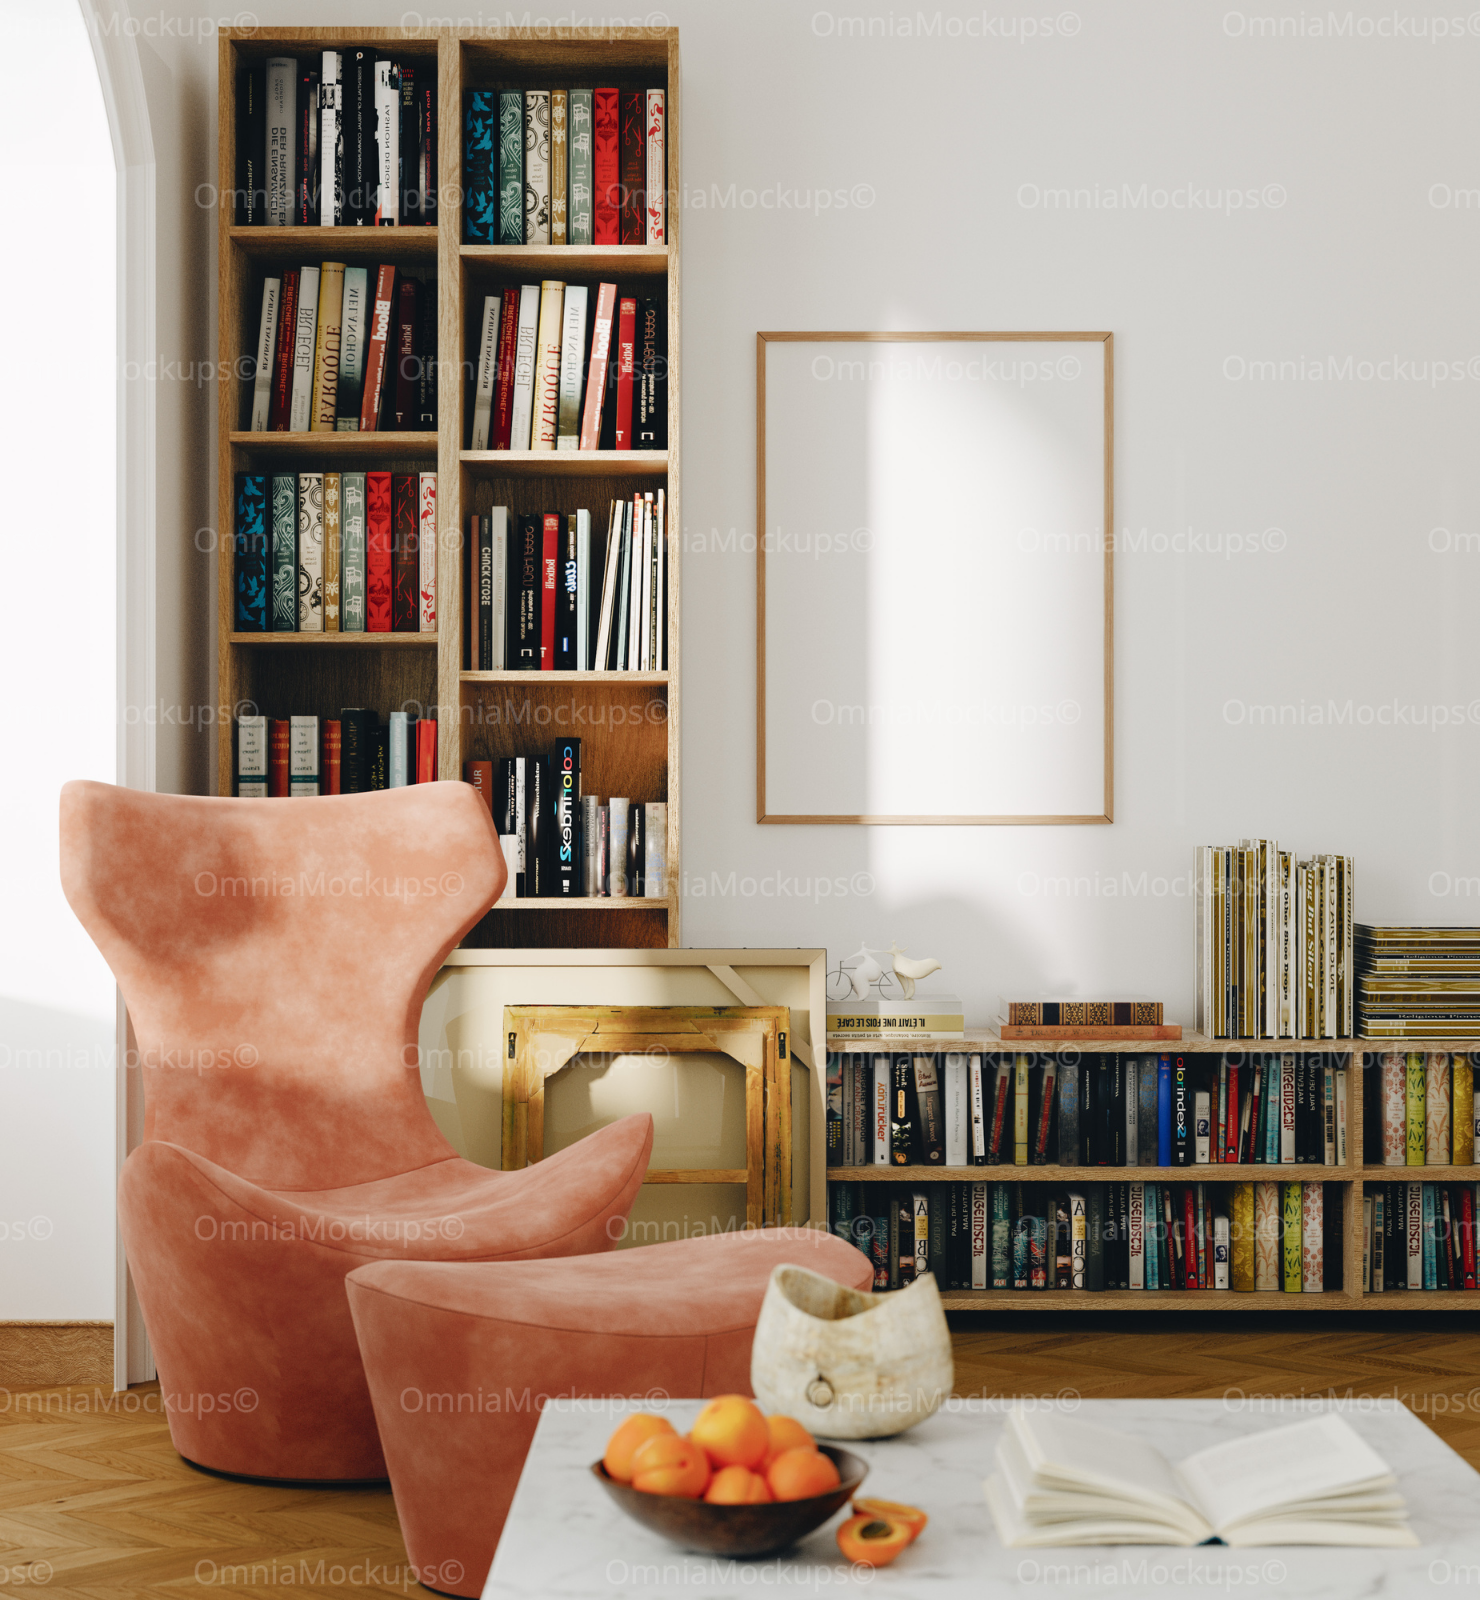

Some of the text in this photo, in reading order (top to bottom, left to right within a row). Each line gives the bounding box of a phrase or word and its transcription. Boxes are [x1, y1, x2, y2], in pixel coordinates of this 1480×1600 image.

[1305, 904, 1314, 990] But Silent
[1281, 963, 1289, 1000] Drops
[835, 1016, 925, 1029] IL ÉTAIT UNE FOIS LE CAFÉ
[853, 1063, 861, 1132] ORYX AND CRAKE
[925, 1096, 936, 1142] Margaret Atwood
[876, 1106, 886, 1142] rucker
[972, 1185, 984, 1257] JUGENDSTIL
[1130, 1185, 1141, 1257] JUGENDSTIL
[1397, 1185, 1405, 1230] MALEVITCH
[1409, 1185, 1420, 1258] JUGENDSTIL
[1445, 1237, 1453, 1280] SYMBOLISMUS
